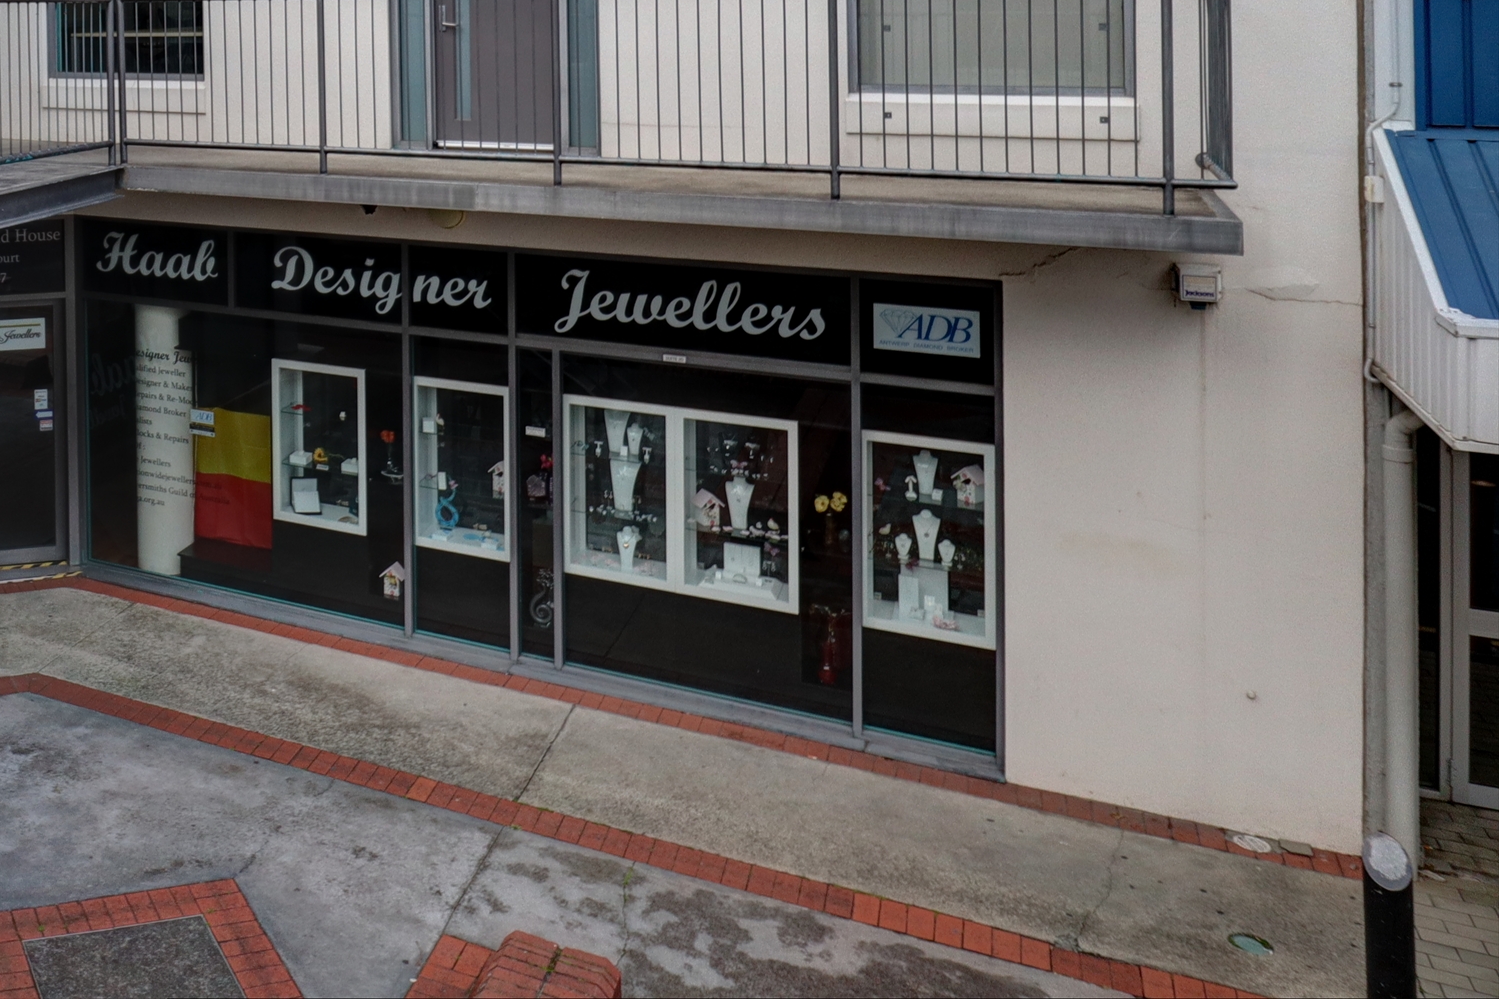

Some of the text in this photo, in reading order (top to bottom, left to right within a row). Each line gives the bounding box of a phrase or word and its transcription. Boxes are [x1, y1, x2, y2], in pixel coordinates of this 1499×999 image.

[15, 228, 61, 243] House
[96, 231, 218, 282] Haab
[554, 268, 826, 341] Jewellers
[895, 313, 973, 345] ADB
[879, 340, 974, 354] ANTWERP DIAMOND BROKER
[135, 348, 170, 362] esigner
[136, 377, 161, 388] esigner
[163, 407, 186, 417] Broker
[163, 433, 189, 444] Repairs
[140, 455, 171, 468] Jewellers
[168, 486, 188, 497] Guild
